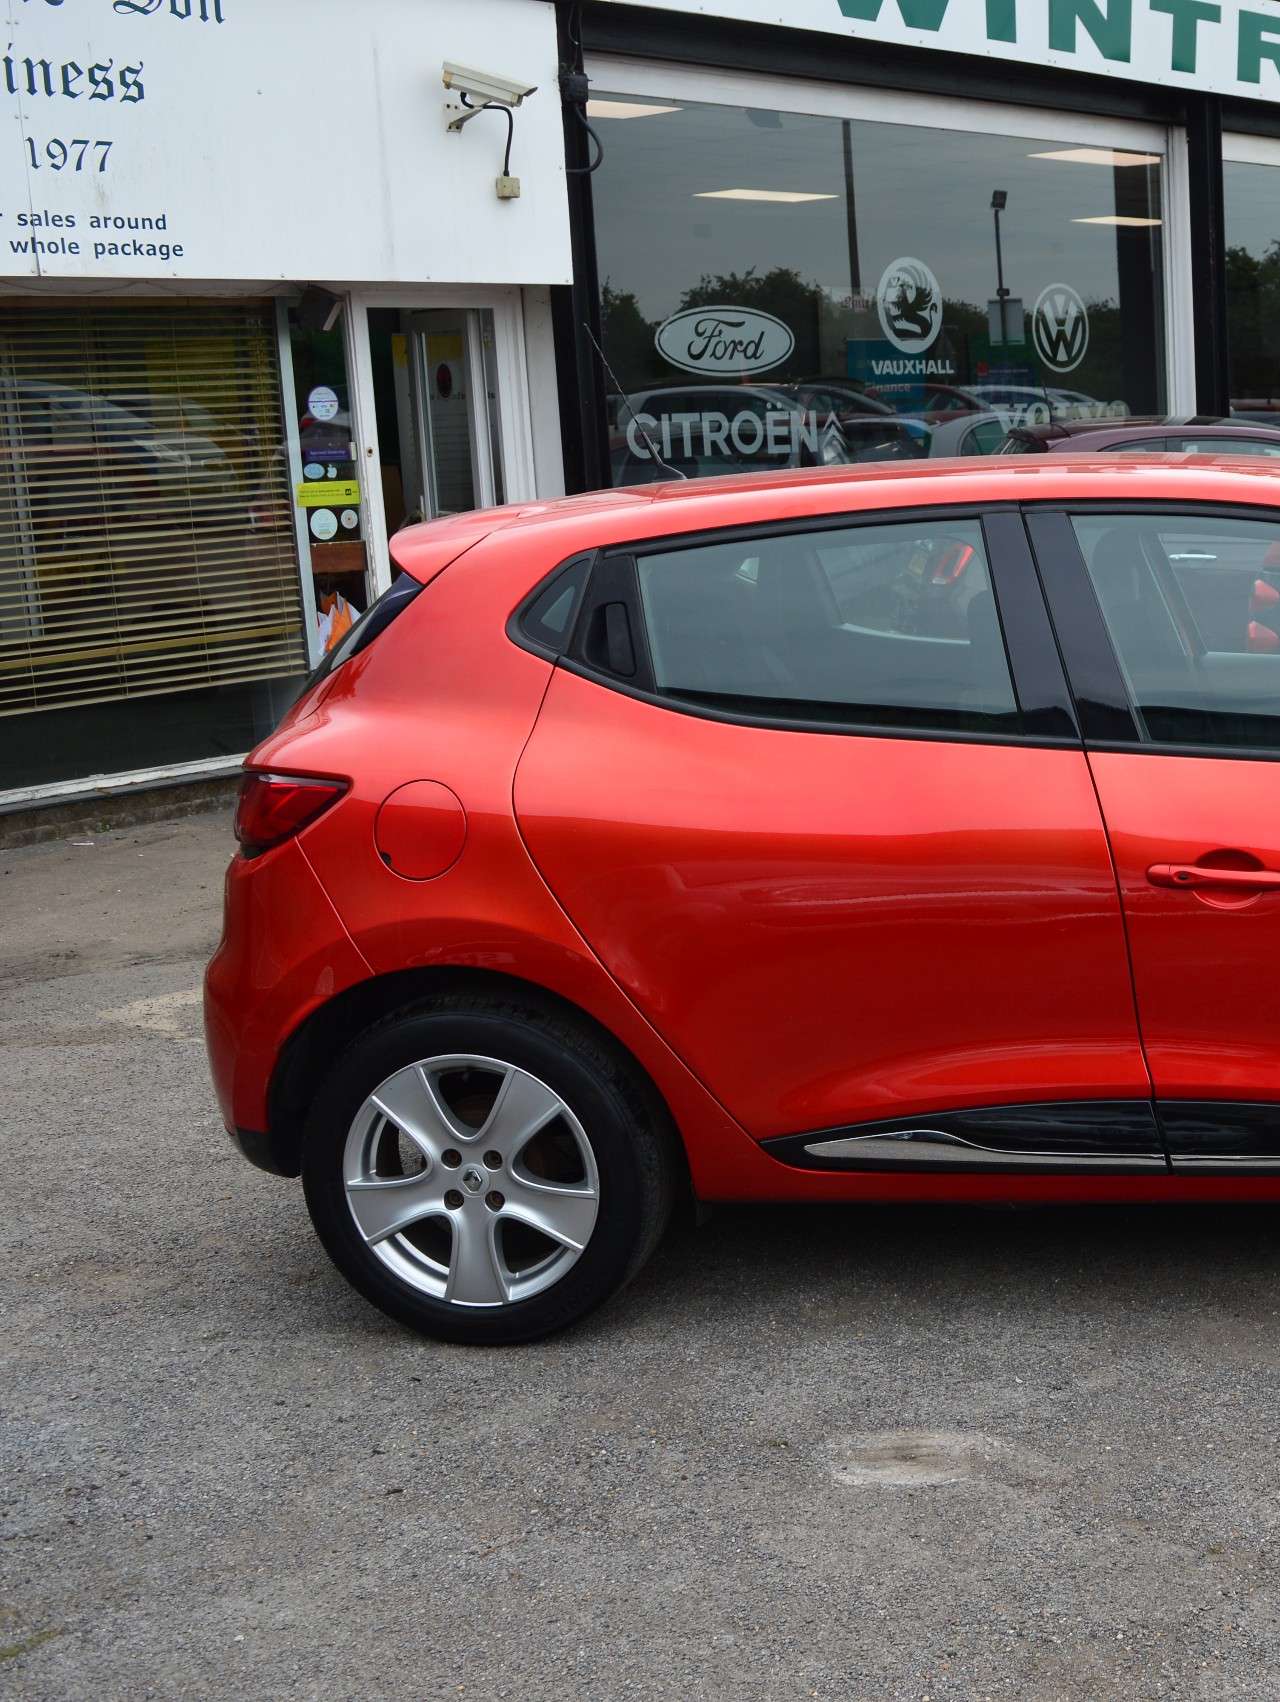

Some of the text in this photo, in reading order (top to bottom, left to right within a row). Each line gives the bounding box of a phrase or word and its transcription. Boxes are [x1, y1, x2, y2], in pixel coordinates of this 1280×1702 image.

[3, 42, 145, 103] iness
[25, 136, 113, 172] 1977
[17, 210, 167, 230] sales around
[9, 237, 184, 260] whole package
[687, 318, 765, 361] Ford
[871, 359, 955, 376] VAUXHALL
[626, 402, 819, 459] CITROËN
